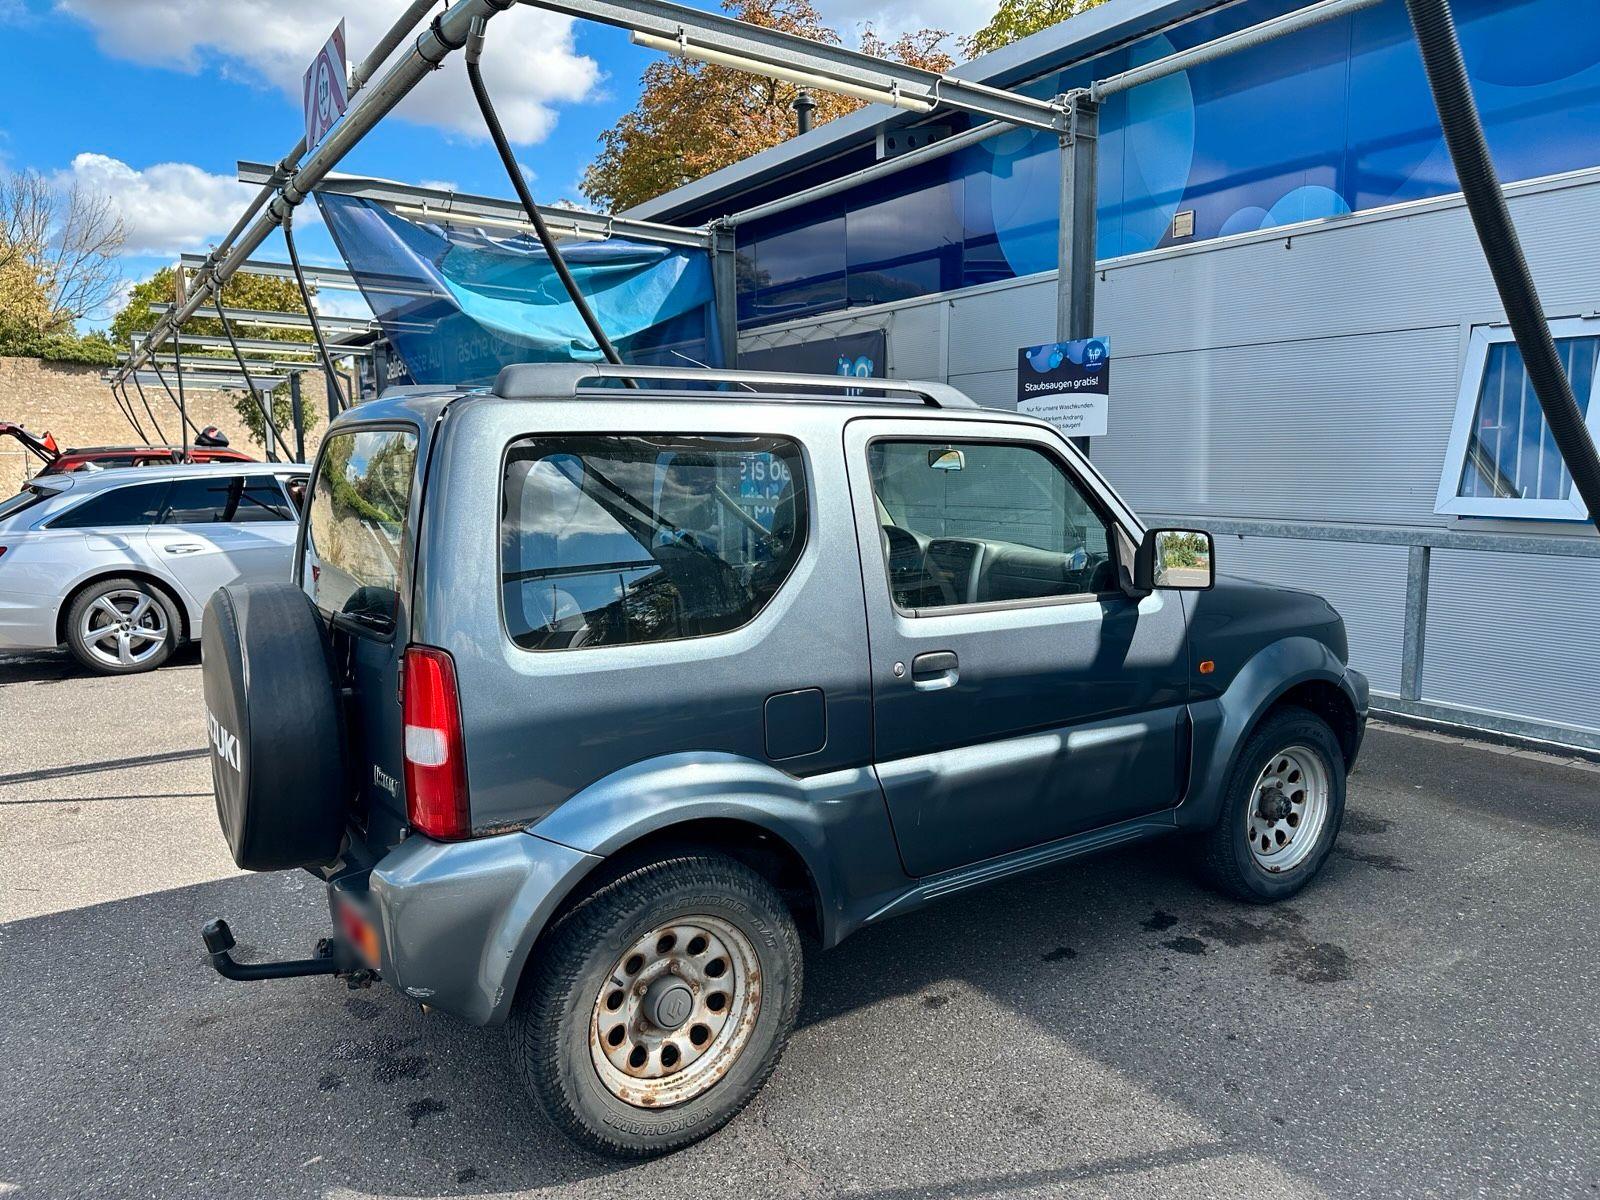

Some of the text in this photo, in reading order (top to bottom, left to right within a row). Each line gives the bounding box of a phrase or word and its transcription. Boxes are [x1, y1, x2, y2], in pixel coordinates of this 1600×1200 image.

[1024, 376, 1099, 392] Staubsaugen gratis!
[602, 1106, 713, 1136] YOKOHAMA
